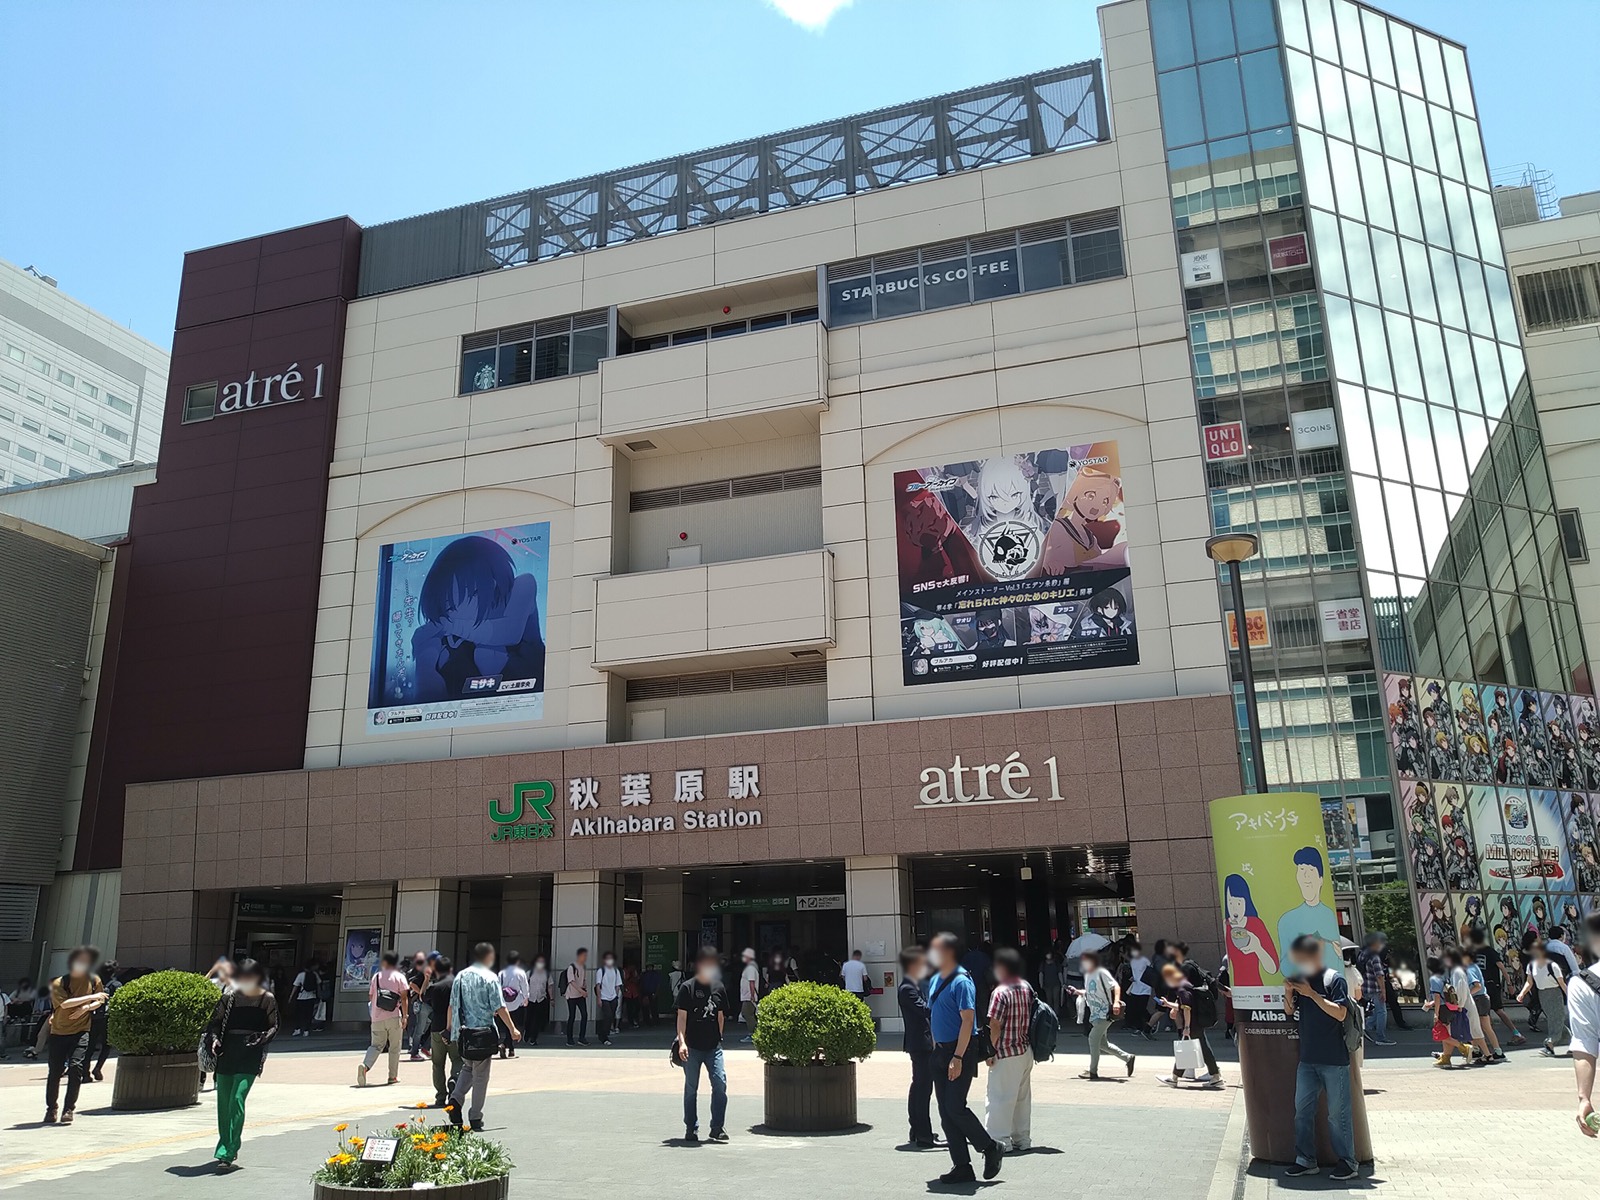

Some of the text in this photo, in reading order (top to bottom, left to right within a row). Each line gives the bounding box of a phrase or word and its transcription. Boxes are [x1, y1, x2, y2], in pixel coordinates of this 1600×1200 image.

[841, 260, 1010, 301] STARBUCKS COFFEE
[219, 362, 304, 413] atré
[1209, 429, 1235, 442] UNI
[1298, 423, 1332, 434] 3COINS
[1210, 441, 1239, 456] QLO
[1078, 456, 1108, 467] YOSTAR
[518, 535, 541, 543] YOSTAR
[1324, 607, 1360, 621] 三省堂
[1338, 619, 1362, 631] 書店
[469, 677, 495, 689] ミサキ
[919, 751, 1032, 804] atré
[569, 765, 761, 810] 秋葉原駅
[488, 780, 555, 823] JR
[570, 807, 762, 836] Akihabara Station
[490, 823, 554, 841] JR東日本
[1531, 846, 1559, 861] LVE!
[1251, 1010, 1300, 1021] Akiba S
